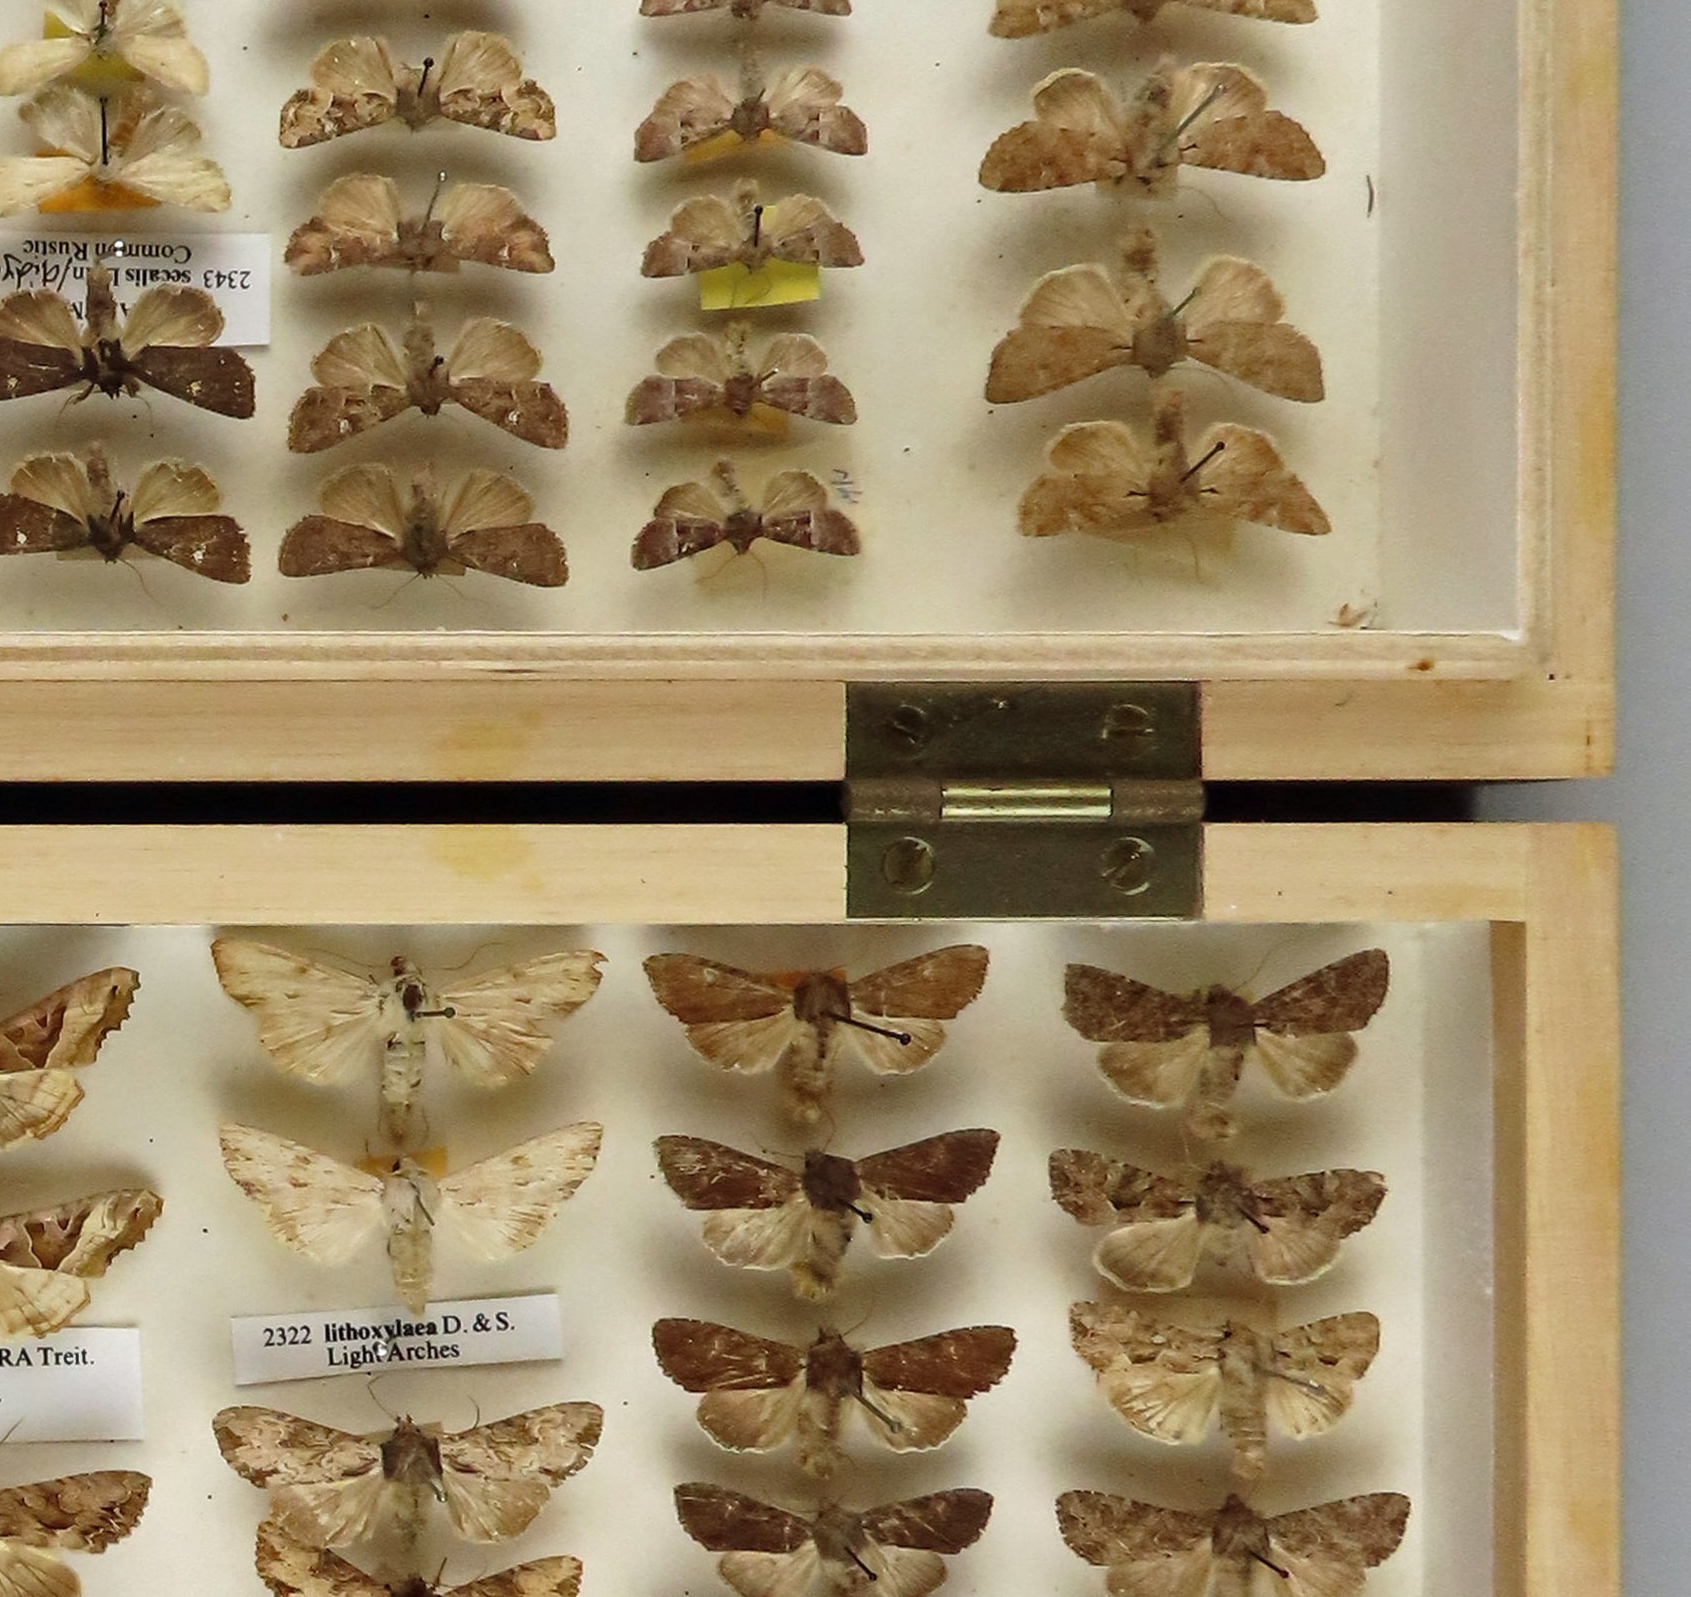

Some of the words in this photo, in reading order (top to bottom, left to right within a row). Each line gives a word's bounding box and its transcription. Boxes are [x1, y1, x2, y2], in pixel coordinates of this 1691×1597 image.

[22, 239, 88, 261] Rustic
[125, 268, 191, 286] secalis
[203, 270, 251, 288] 2343
[263, 1325, 312, 1347] 2322
[324, 1319, 438, 1343] lithoxylaea
[442, 1315, 467, 1335] D.
[473, 1315, 491, 1332] &
[496, 1311, 515, 1330] S.
[37, 1347, 94, 1367] Treit.
[387, 1339, 460, 1362] Arches
